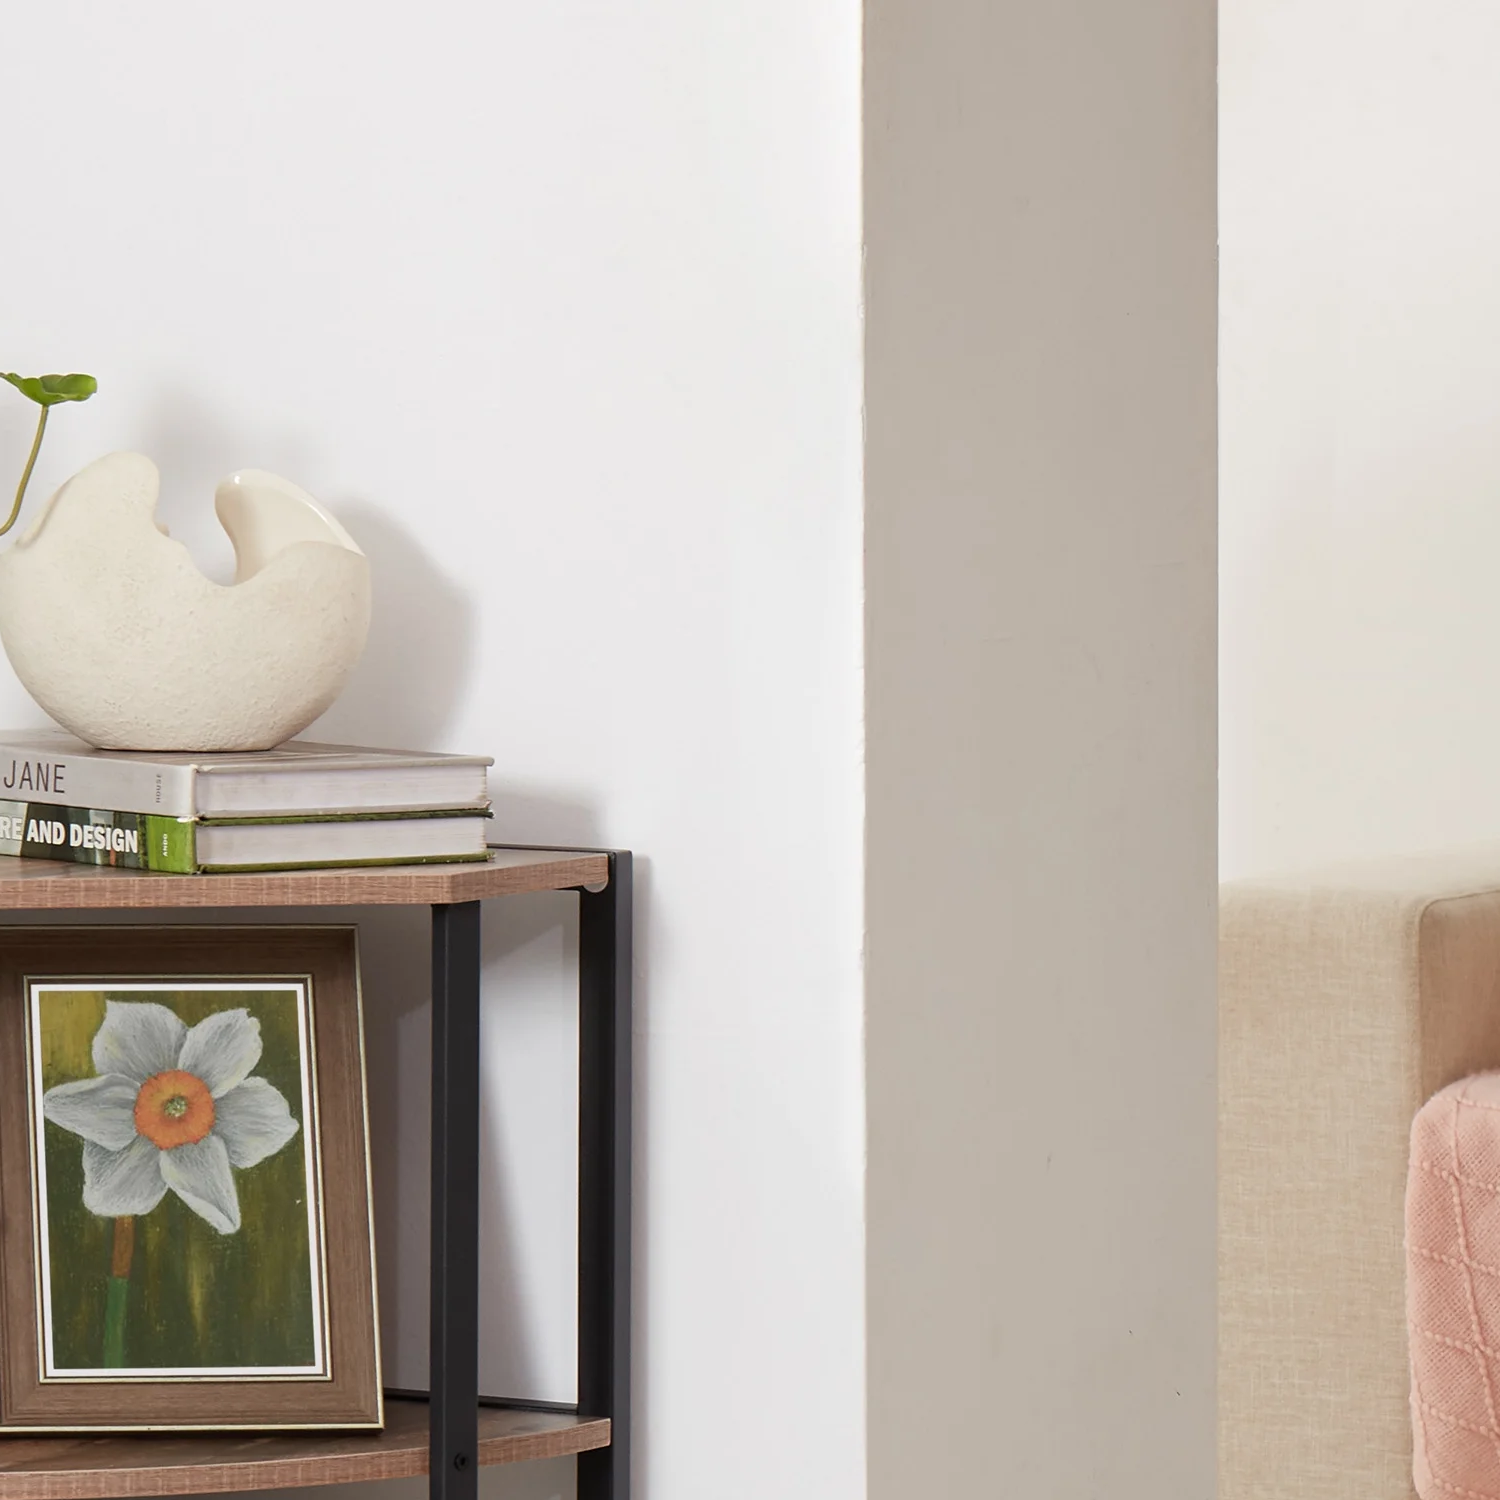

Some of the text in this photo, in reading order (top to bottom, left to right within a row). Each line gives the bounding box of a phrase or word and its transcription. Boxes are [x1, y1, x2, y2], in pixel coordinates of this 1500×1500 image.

[4, 760, 66, 794] JANE
[155, 773, 163, 804] HOUSE
[26, 819, 66, 846] AND
[69, 823, 139, 854] DESIGN
